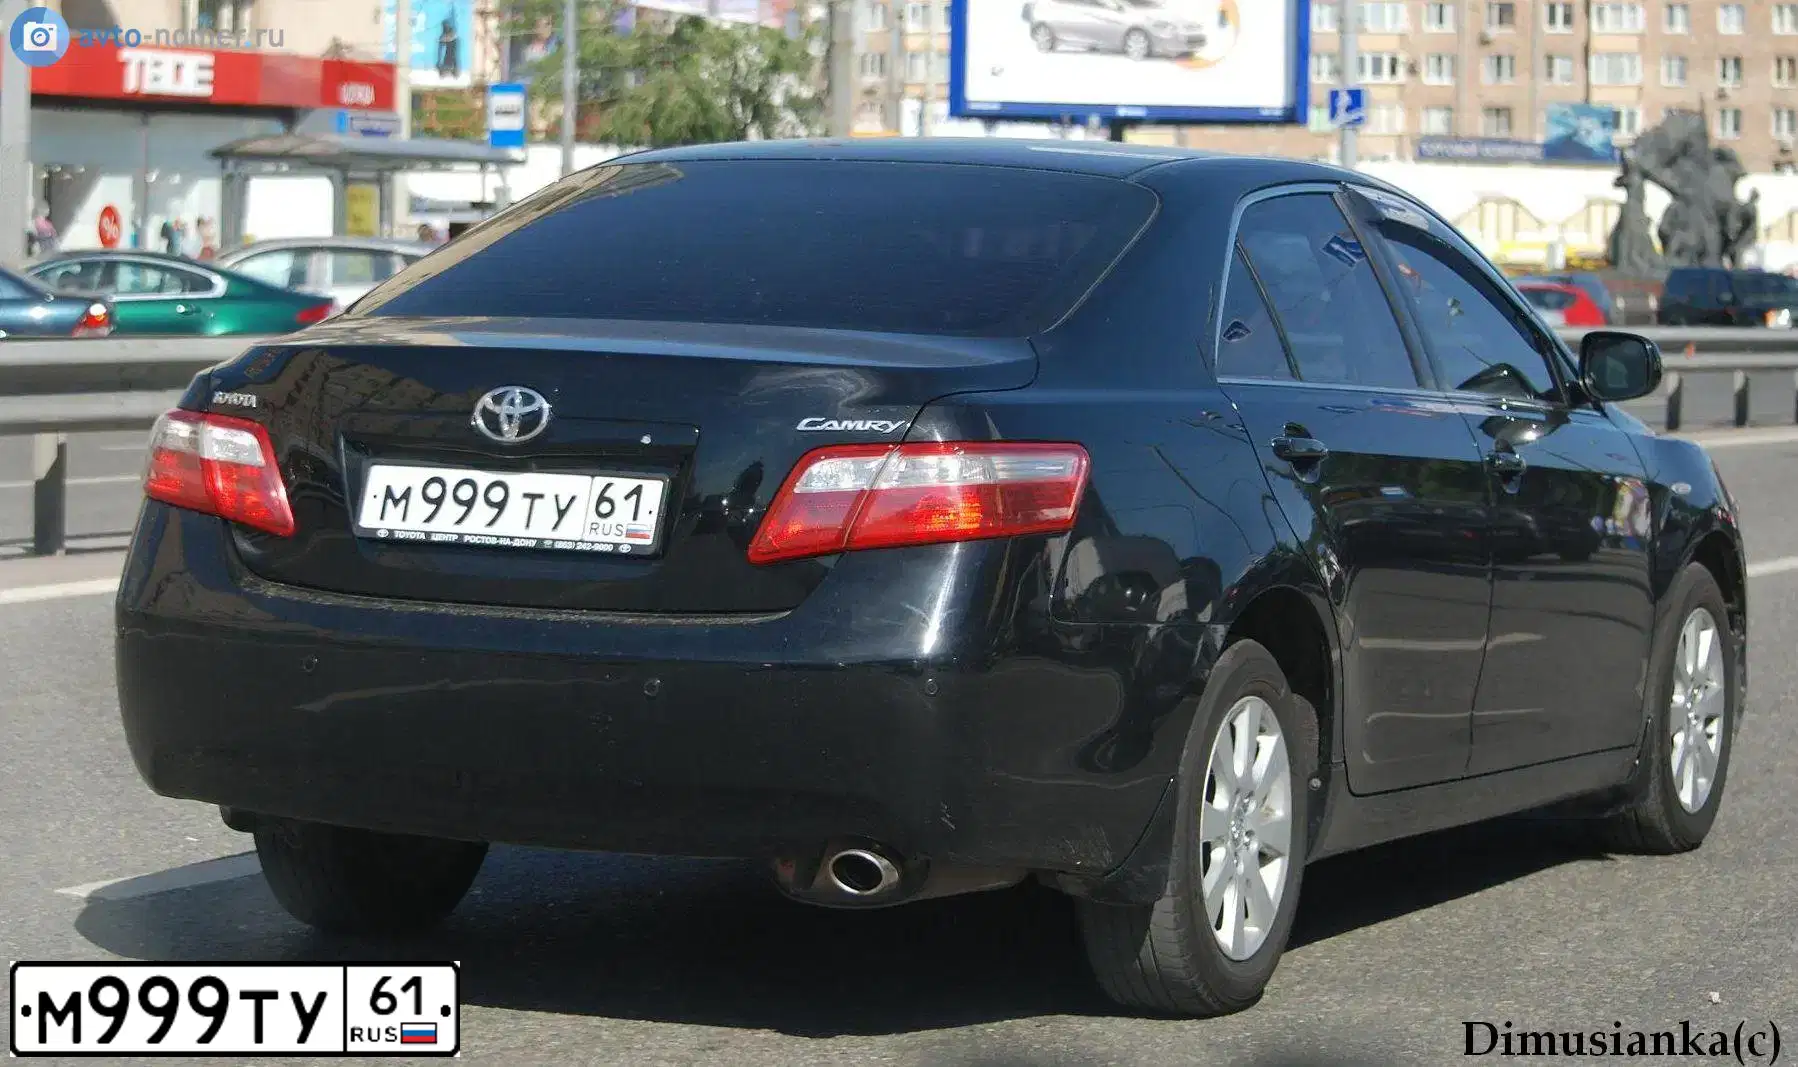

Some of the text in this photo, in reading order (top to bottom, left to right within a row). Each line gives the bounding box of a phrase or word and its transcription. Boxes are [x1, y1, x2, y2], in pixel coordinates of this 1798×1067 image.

[594, 482, 643, 521] 61
[394, 529, 426, 540] TOYOTA
[589, 521, 624, 537] RUS
